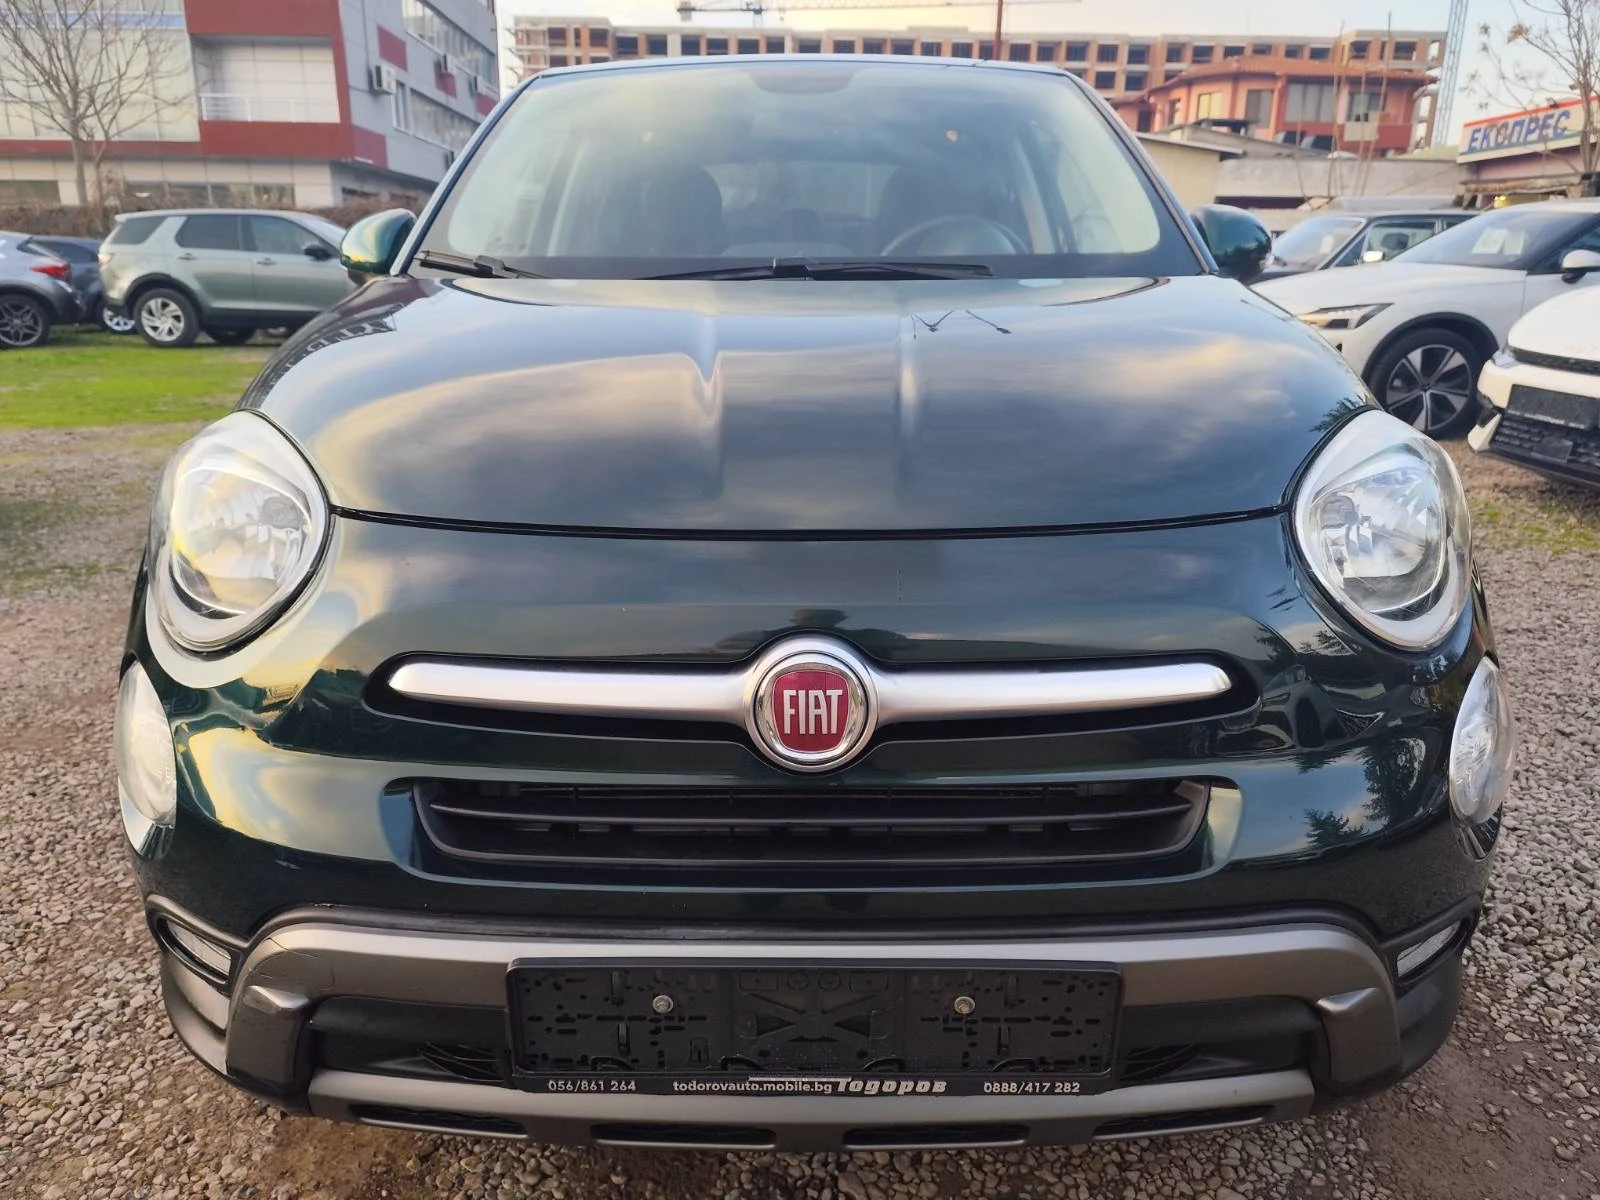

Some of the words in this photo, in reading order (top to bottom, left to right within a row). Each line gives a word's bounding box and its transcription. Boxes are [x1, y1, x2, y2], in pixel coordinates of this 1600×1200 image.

[1467, 110, 1570, 153] ЕКСПРЕС
[783, 689, 843, 735] FIAT
[548, 1080, 604, 1092] 056/861
[610, 1080, 636, 1092] 264
[673, 1080, 833, 1094] todorovauto.mobile.bg
[984, 1082, 1050, 1094] 0888/417
[1055, 1082, 1080, 1094] 282
